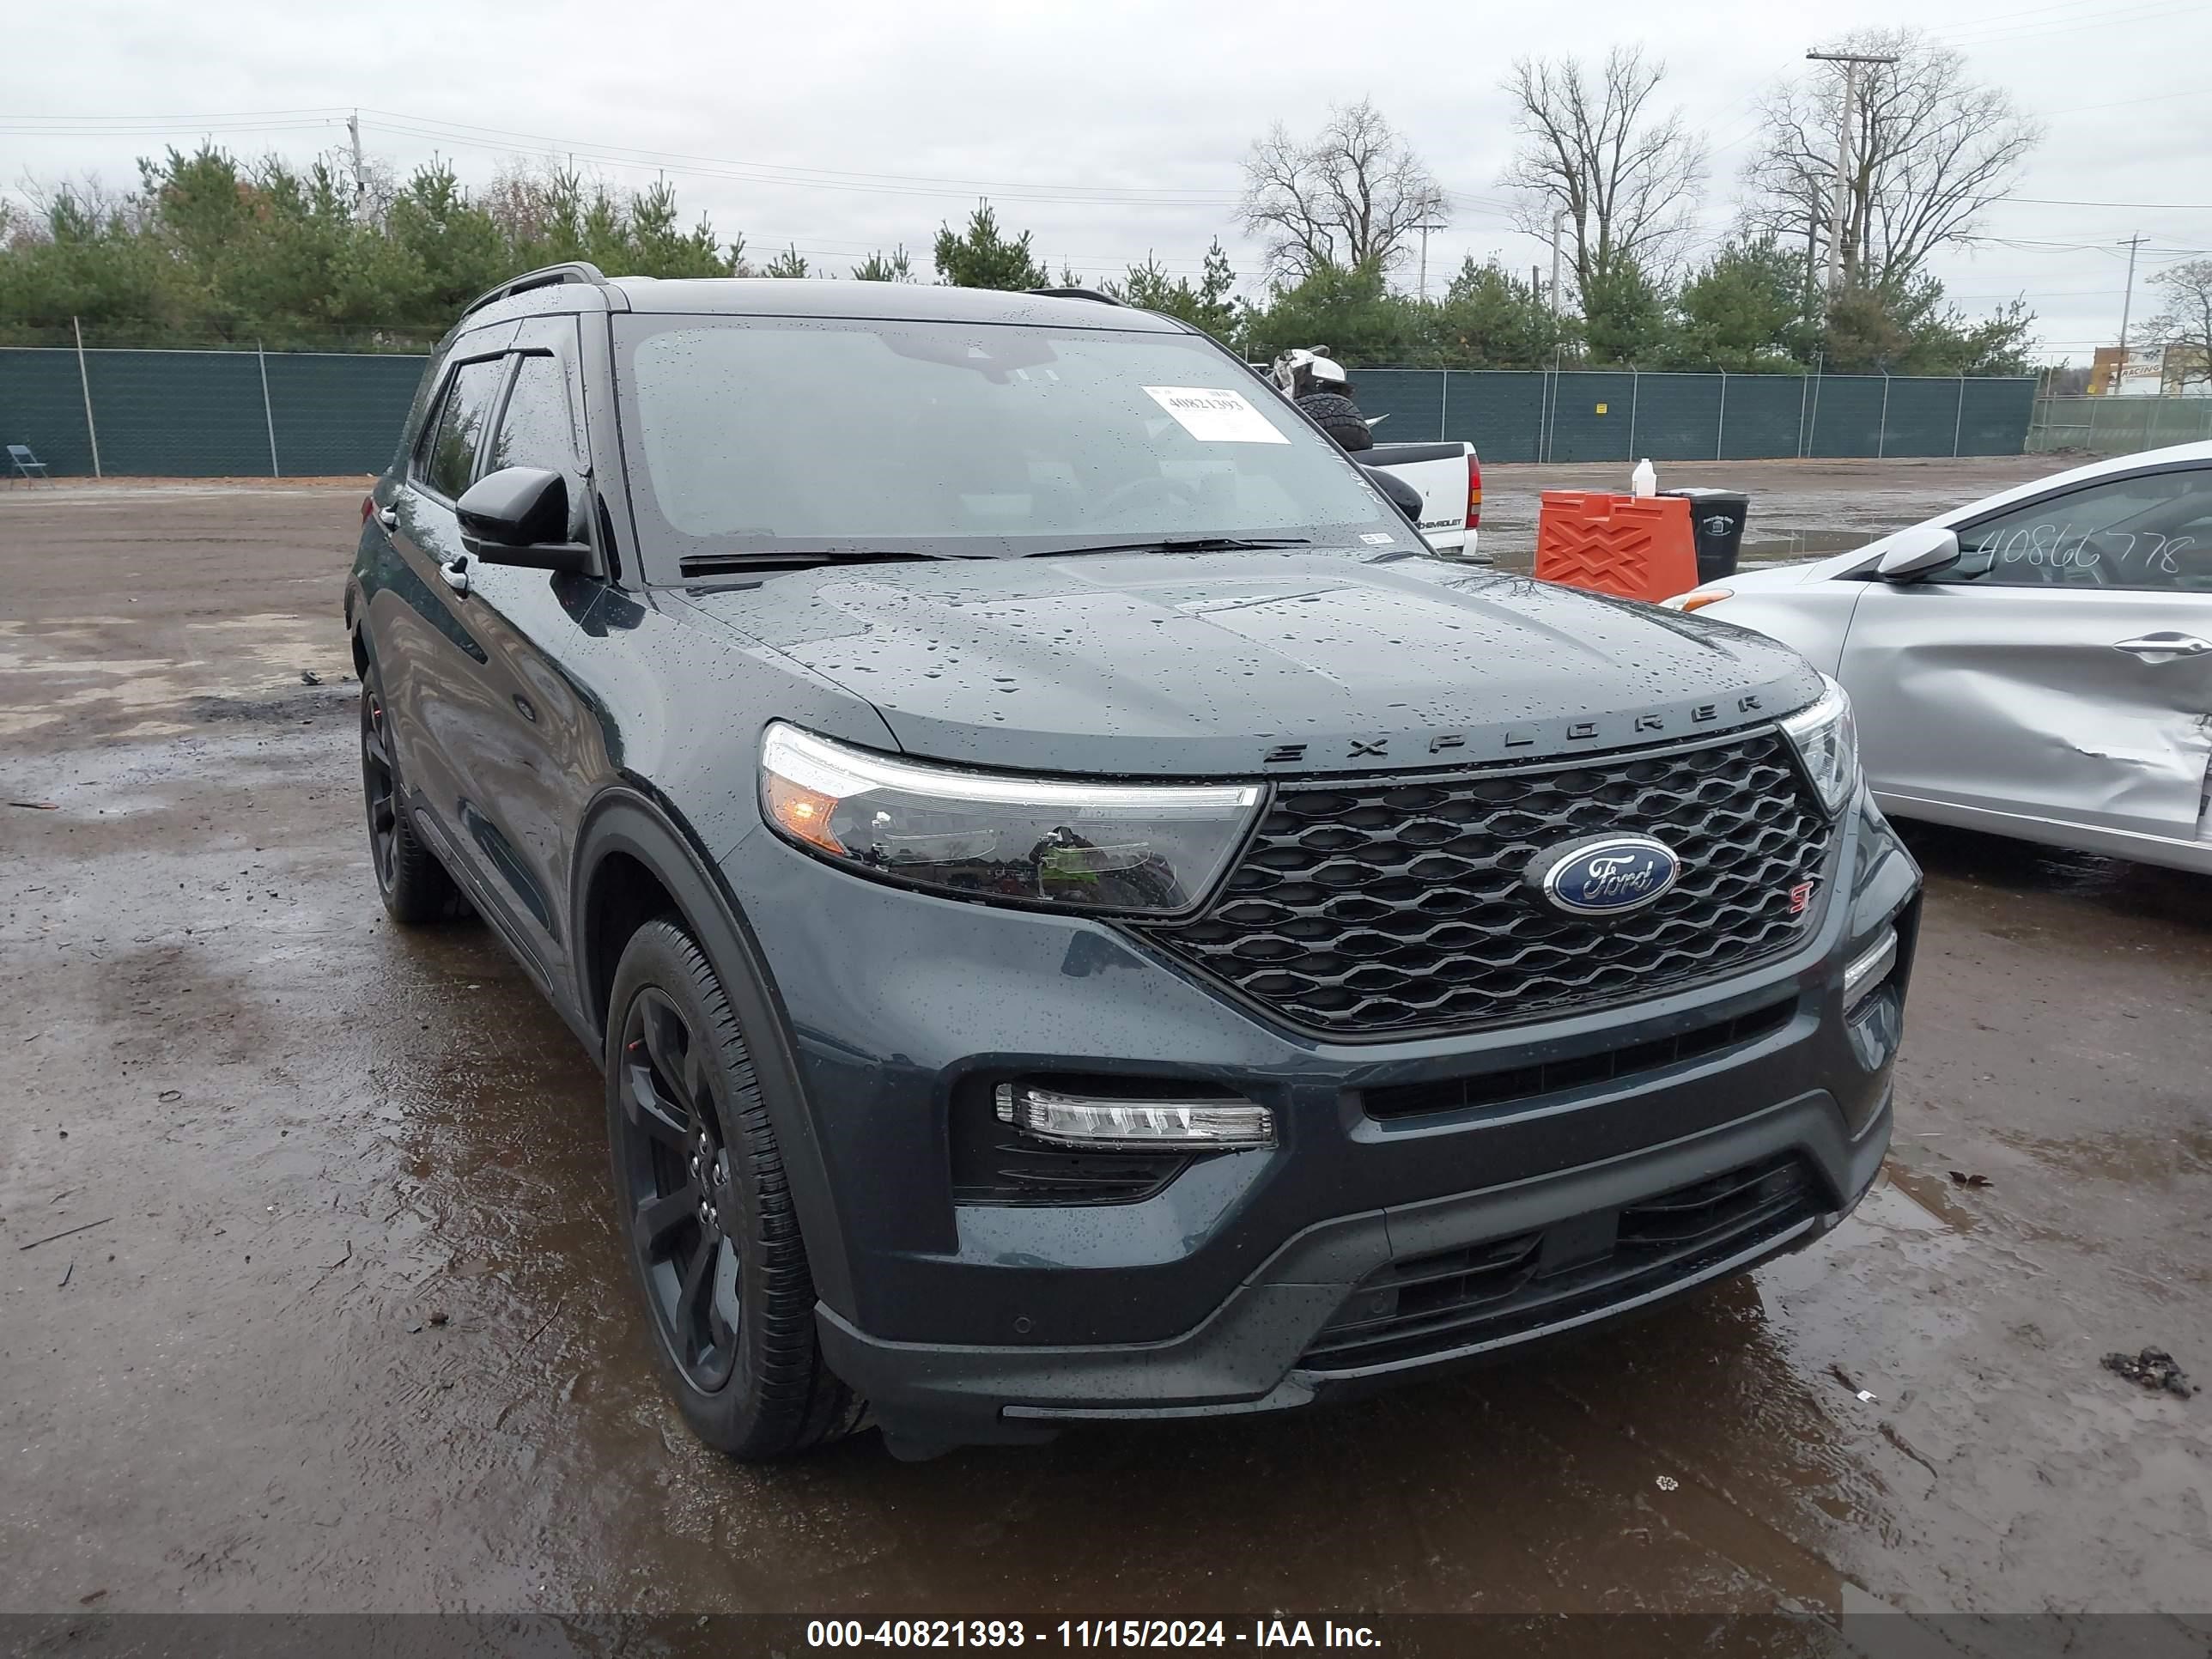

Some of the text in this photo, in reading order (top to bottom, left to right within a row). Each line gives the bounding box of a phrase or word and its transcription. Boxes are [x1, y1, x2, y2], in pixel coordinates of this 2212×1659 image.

[2121, 364, 2160, 377] RACING
[1169, 398, 1244, 410] 40821393
[1264, 695, 1763, 763] EXPLORER
[1583, 854, 1654, 900] Ford
[1789, 880, 1814, 915] ST
